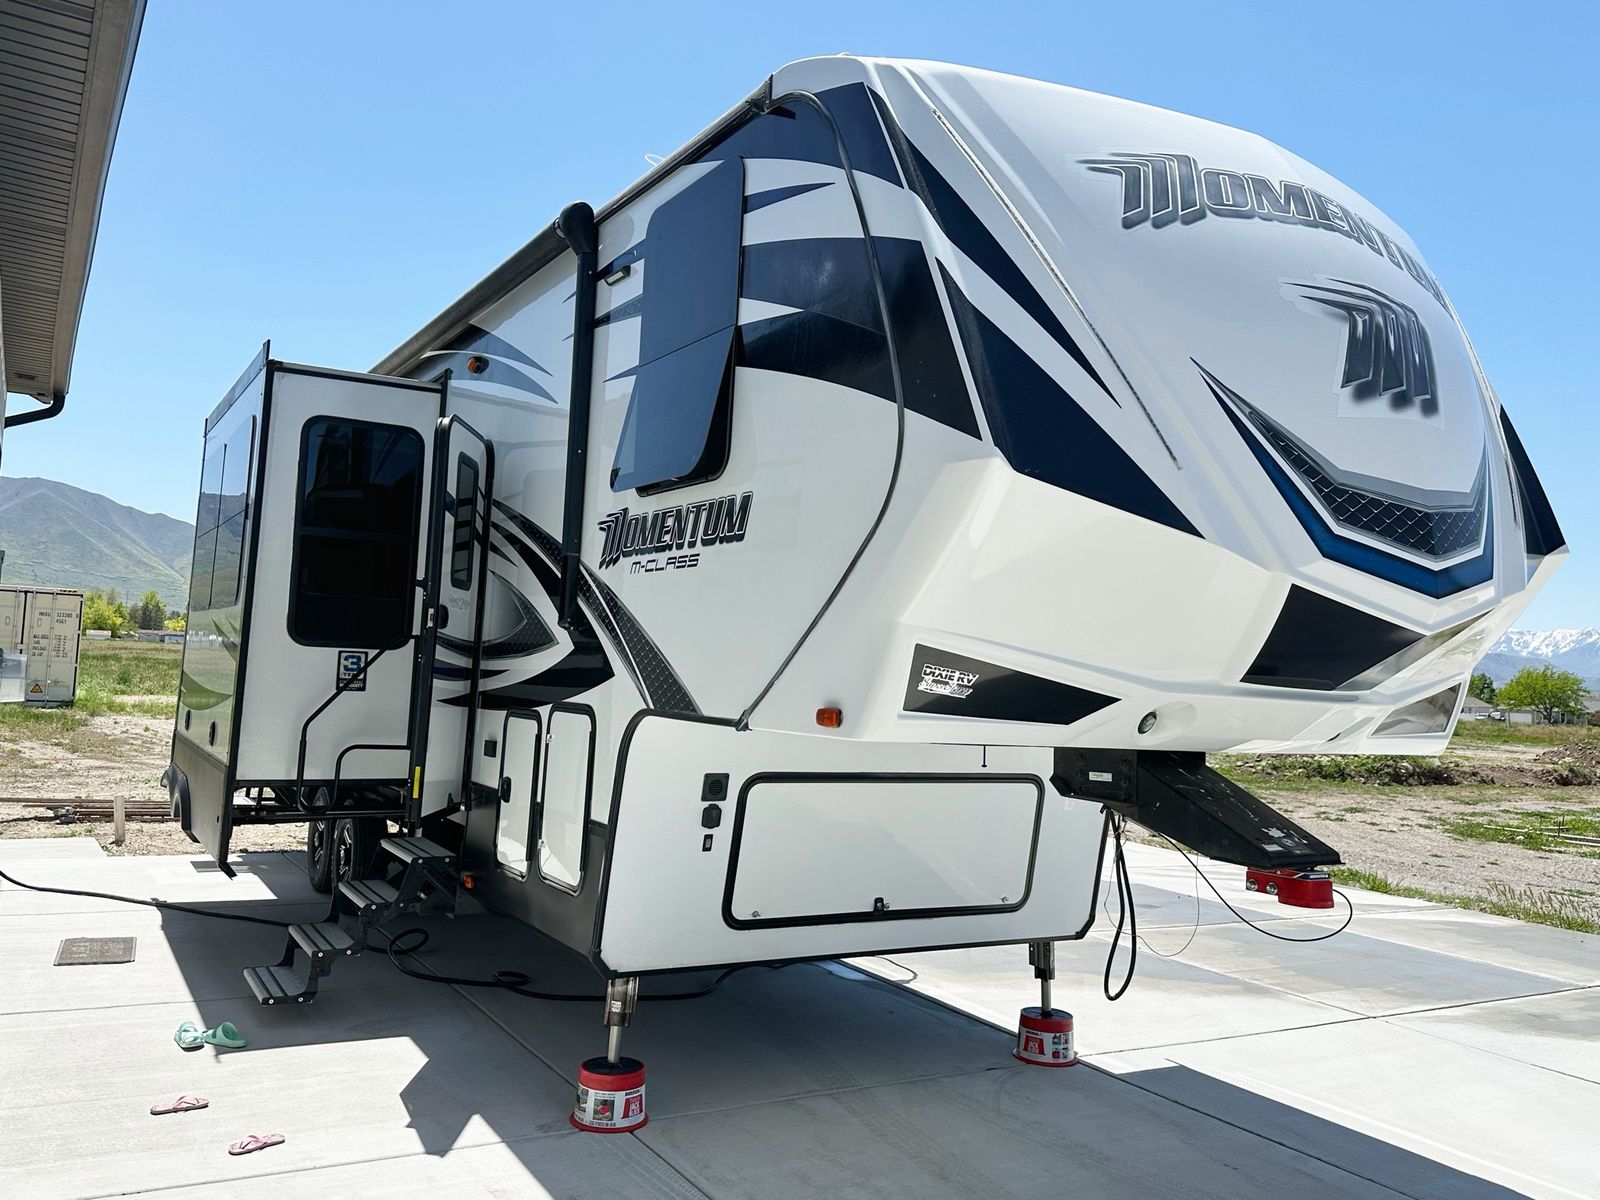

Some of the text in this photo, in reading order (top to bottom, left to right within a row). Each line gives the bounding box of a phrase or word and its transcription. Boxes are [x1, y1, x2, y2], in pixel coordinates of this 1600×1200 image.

[598, 491, 753, 569] MOMENTUM
[630, 553, 700, 574] M-CLASS
[343, 655, 361, 671] 3
[922, 664, 956, 681] DIXIE
[957, 671, 978, 685] RV
